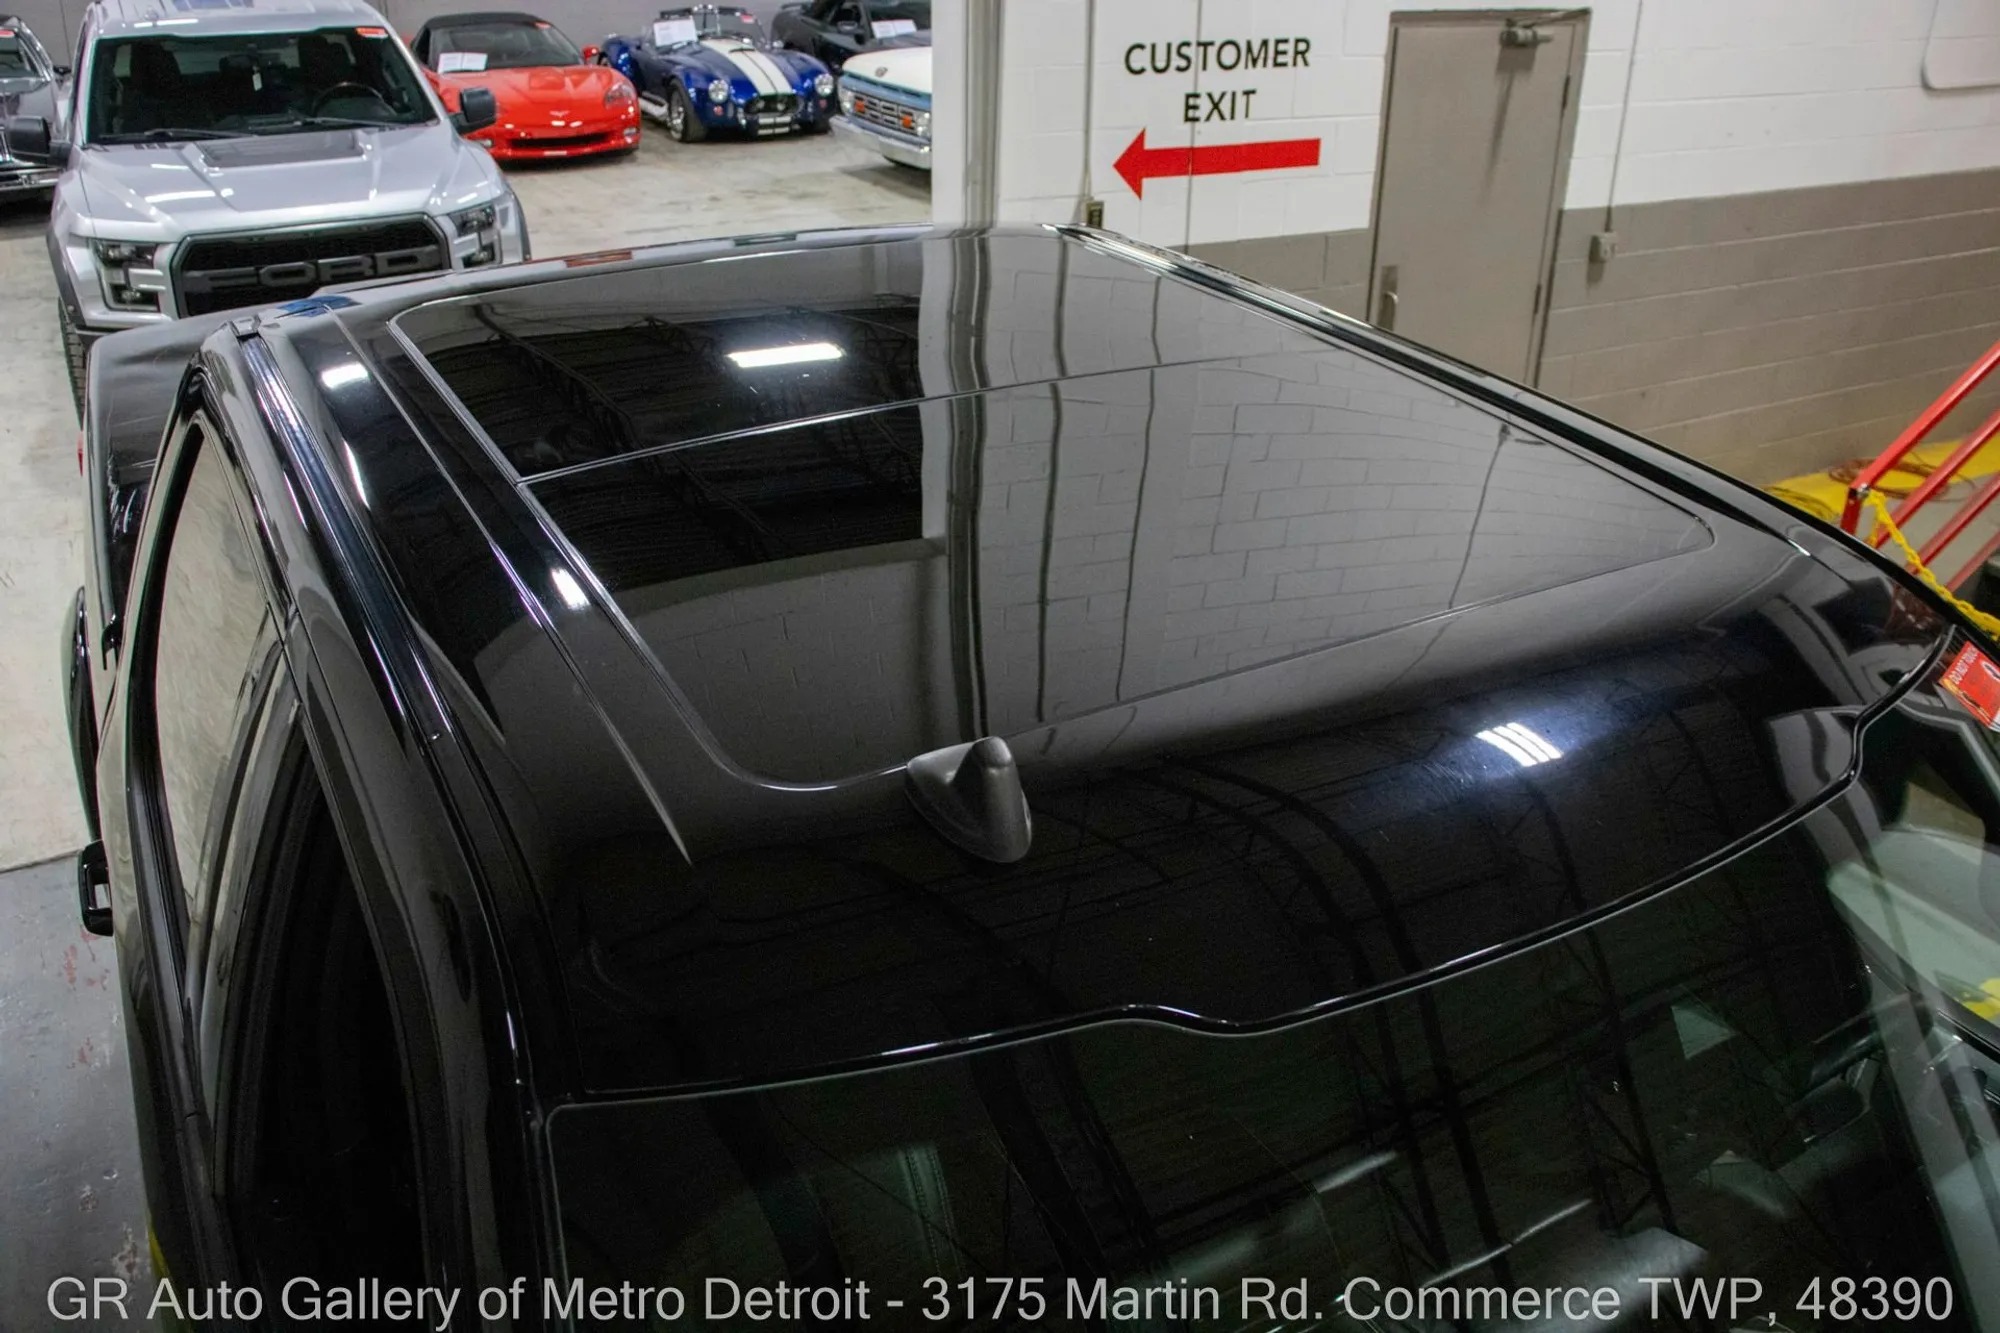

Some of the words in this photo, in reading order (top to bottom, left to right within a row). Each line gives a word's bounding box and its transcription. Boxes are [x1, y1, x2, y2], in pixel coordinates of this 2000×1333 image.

[1124, 37, 1312, 76] CUSTOMER
[1183, 88, 1257, 124] EXIT
[183, 244, 444, 294] FORD
